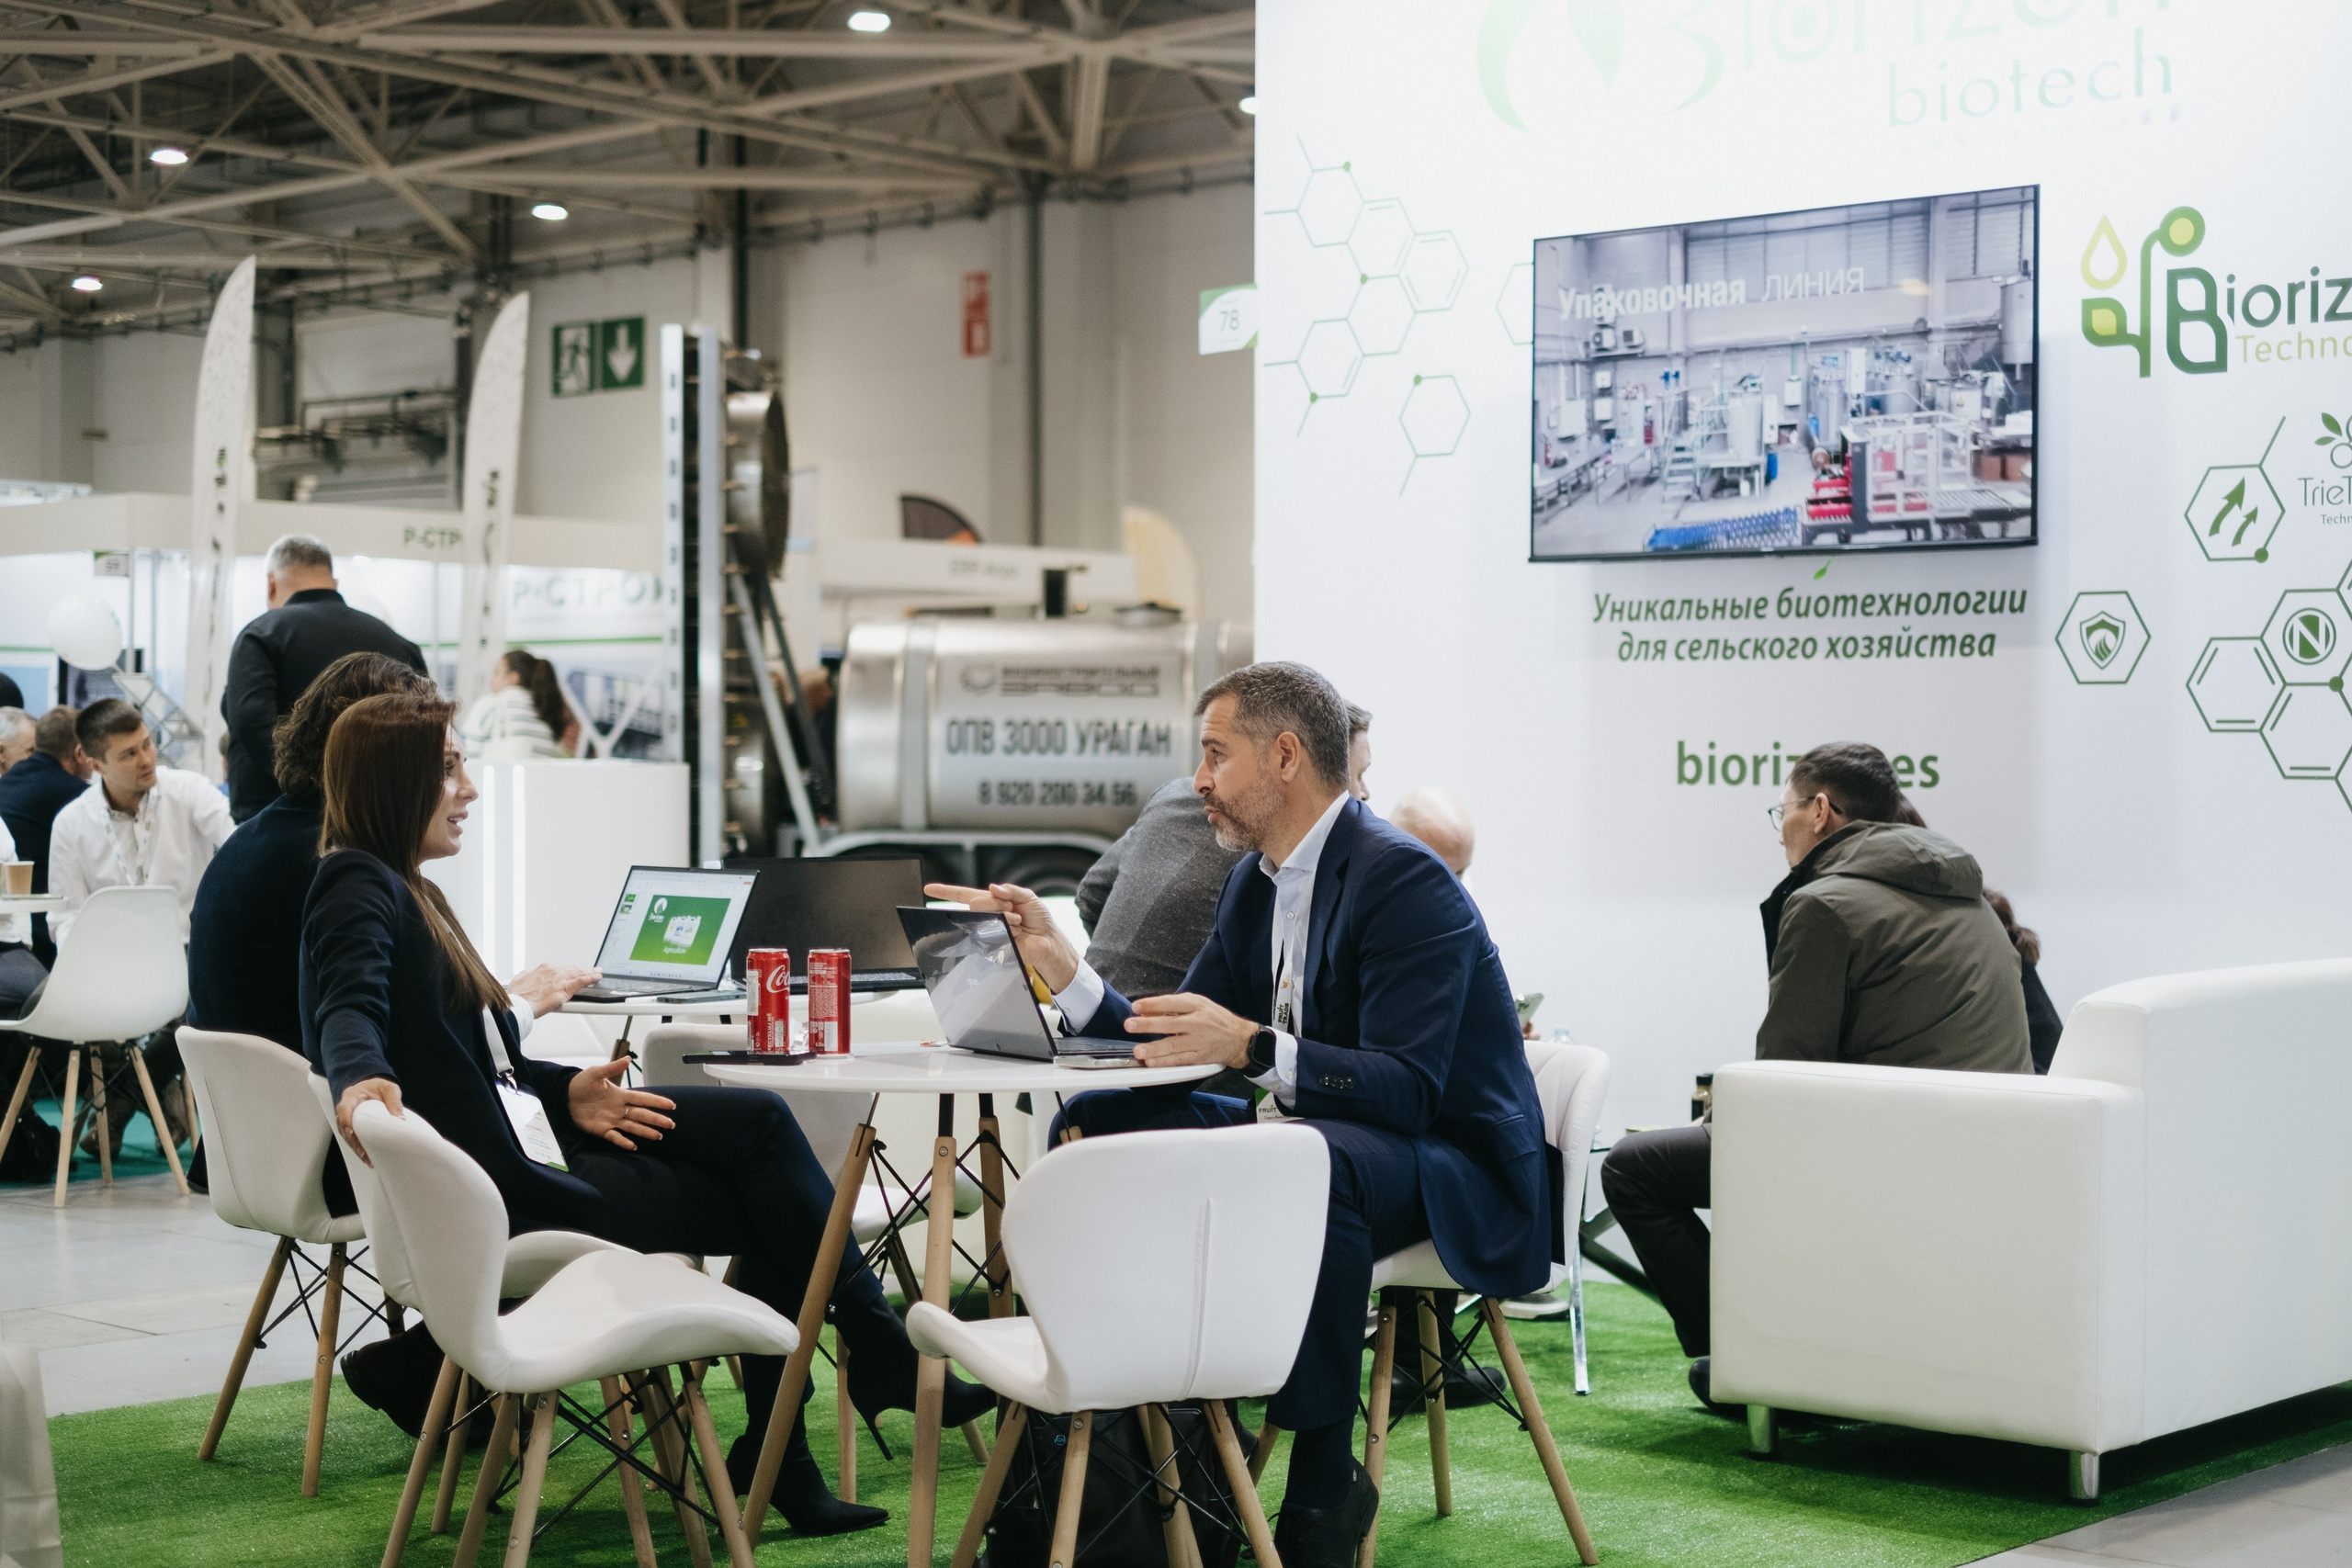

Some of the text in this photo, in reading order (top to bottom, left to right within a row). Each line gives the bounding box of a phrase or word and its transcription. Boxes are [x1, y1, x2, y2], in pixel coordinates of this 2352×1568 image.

[1888, 27, 2172, 129] biotech
[1558, 278, 1746, 321] Упаковочная
[1219, 309, 1240, 332] 78
[1593, 586, 2028, 623] Уникальные биотехнологии
[1618, 626, 1996, 661] для сельского хозяйства
[946, 719, 1171, 755] ОПВ 3000 УРАГАН
[978, 781, 992, 806] 8
